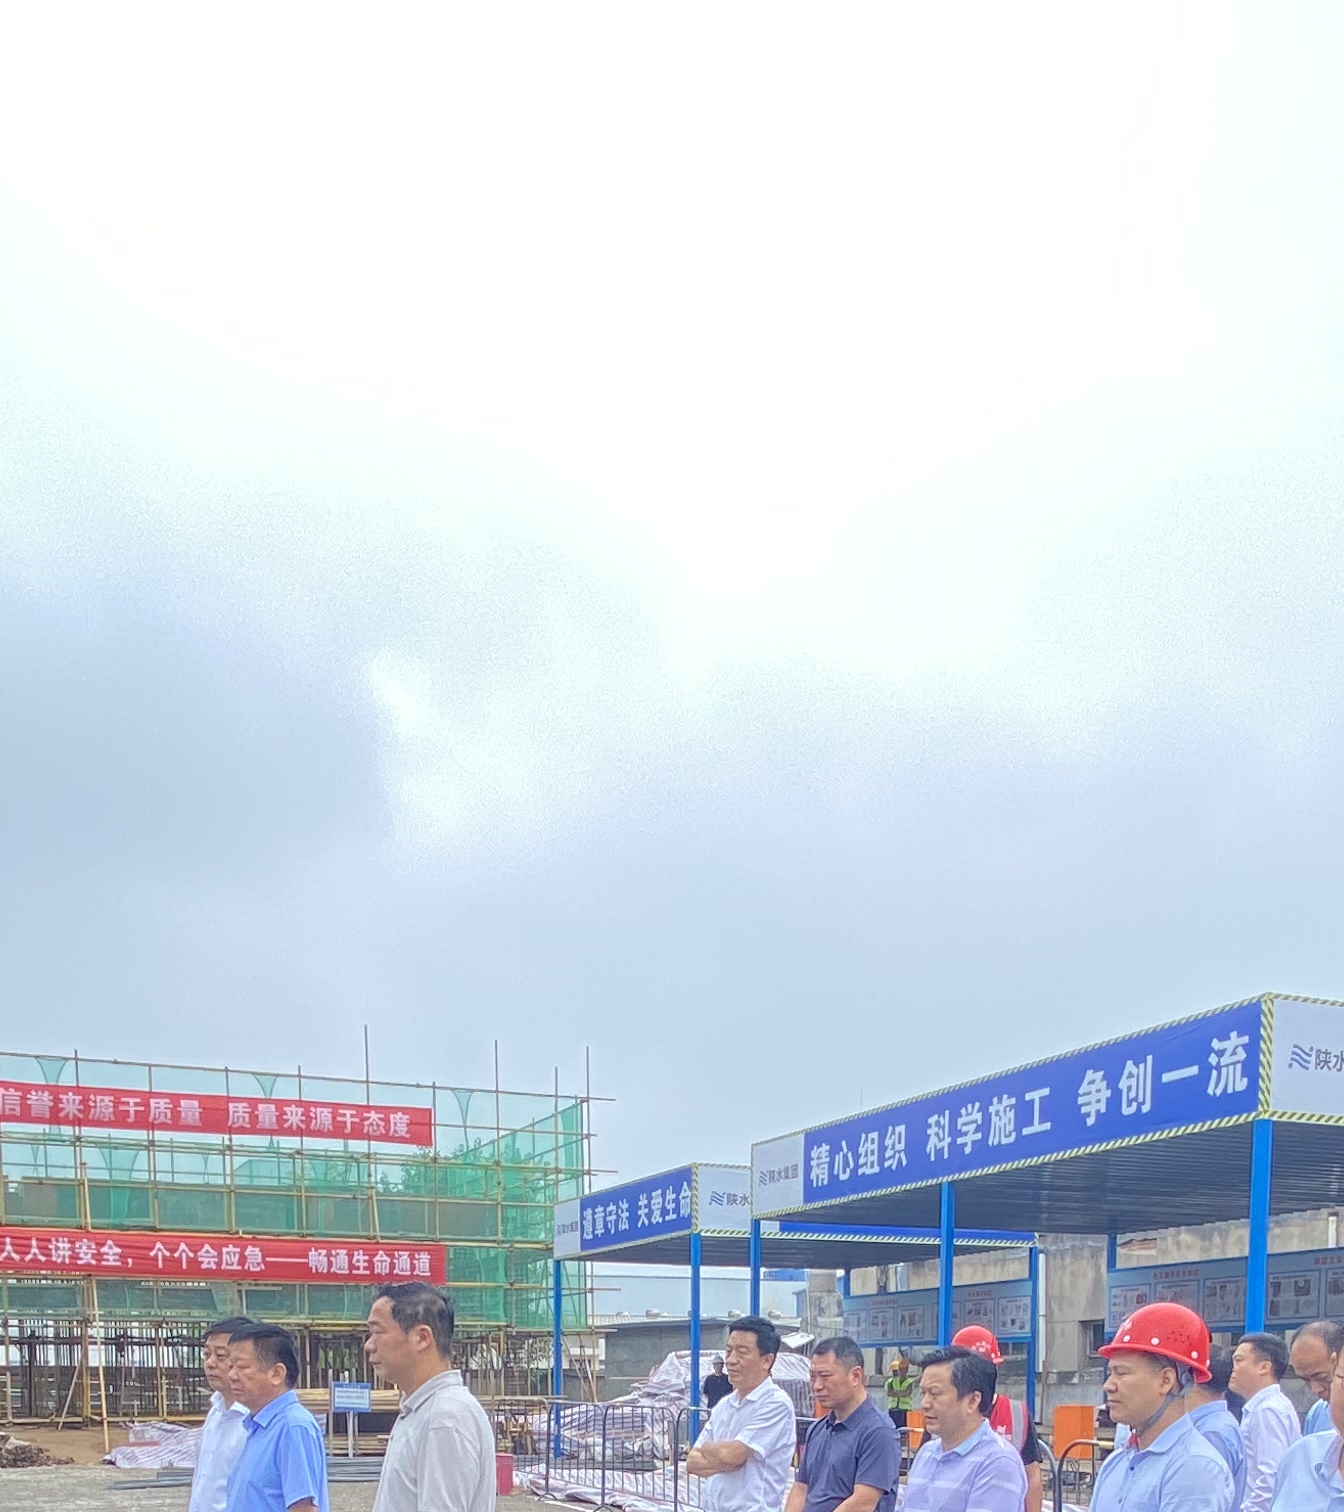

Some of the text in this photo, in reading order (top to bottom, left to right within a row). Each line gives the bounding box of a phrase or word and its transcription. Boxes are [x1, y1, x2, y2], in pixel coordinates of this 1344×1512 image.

[227, 1101, 412, 1139] 质量来源于态度
[809, 1030, 1250, 1188] 精心组织 科学施工 争创一流
[582, 1181, 692, 1240] 遵章守法 关爱生命
